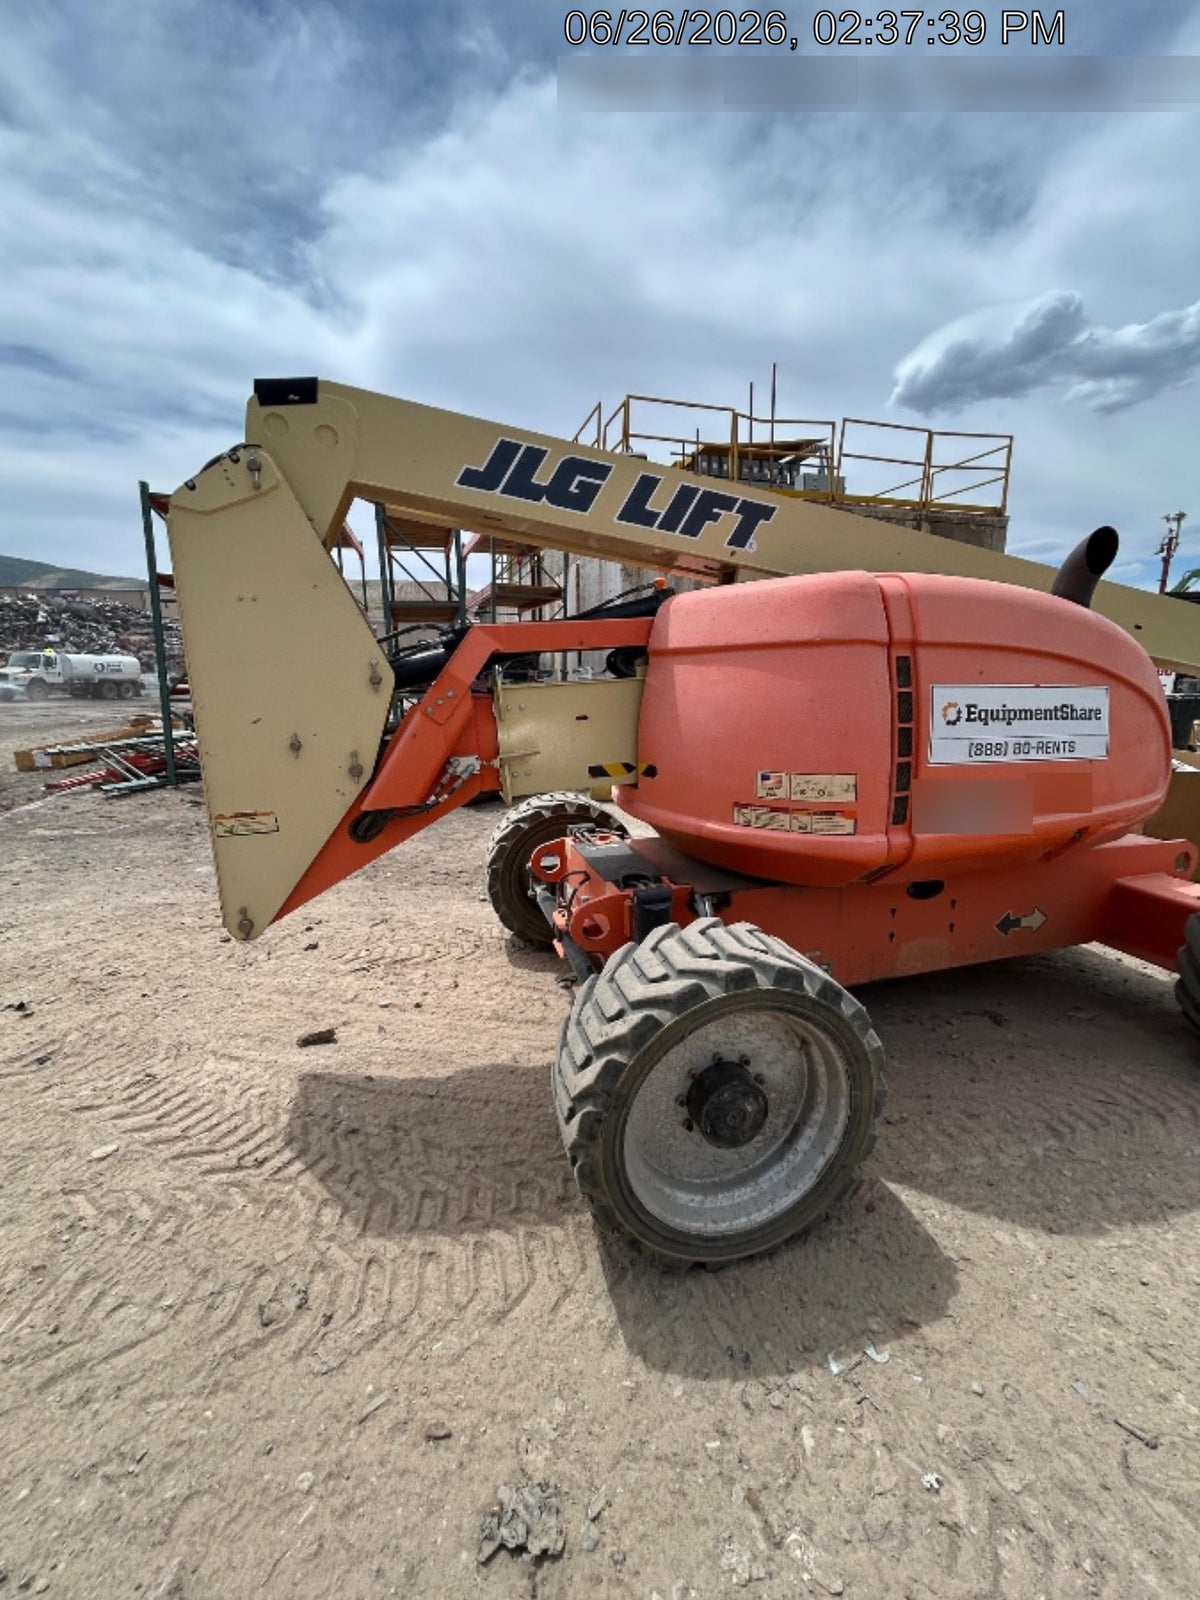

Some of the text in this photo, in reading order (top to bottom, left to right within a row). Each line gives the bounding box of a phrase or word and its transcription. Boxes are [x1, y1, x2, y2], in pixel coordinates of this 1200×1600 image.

[454, 438, 779, 550] JLG LIFT
[965, 704, 1102, 726] EquipmentShare
[968, 741, 1009, 757] (888)
